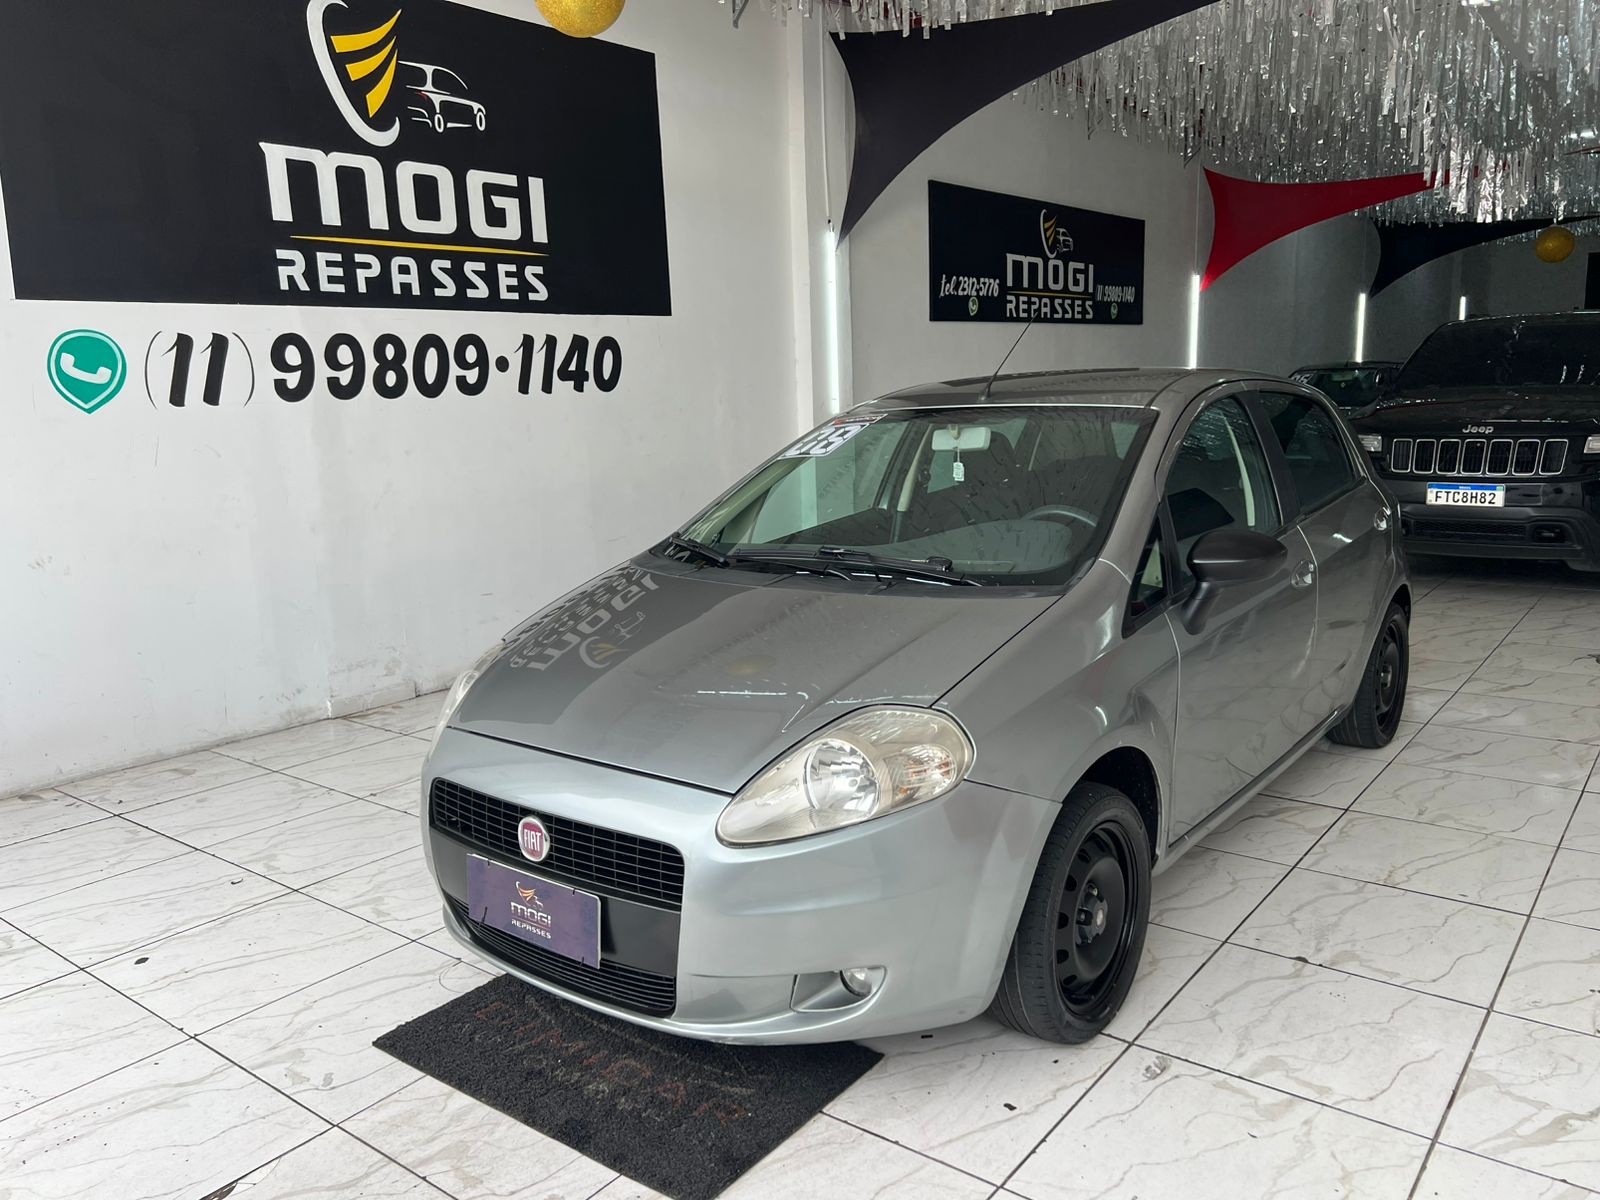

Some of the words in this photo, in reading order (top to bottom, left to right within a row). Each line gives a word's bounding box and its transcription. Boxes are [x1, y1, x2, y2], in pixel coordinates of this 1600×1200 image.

[258, 141, 549, 244] MOGI
[275, 249, 549, 301] REPASSES
[1006, 253, 1094, 293] MOGI
[1006, 296, 1094, 320] REPASSES
[144, 330, 256, 410] (11)
[1462, 424, 1494, 434] Jeep
[1434, 490, 1496, 505] FTC8H82
[523, 829, 541, 852] FIAT
[511, 901, 551, 928] MOGI
[511, 919, 551, 939] REPASSES
